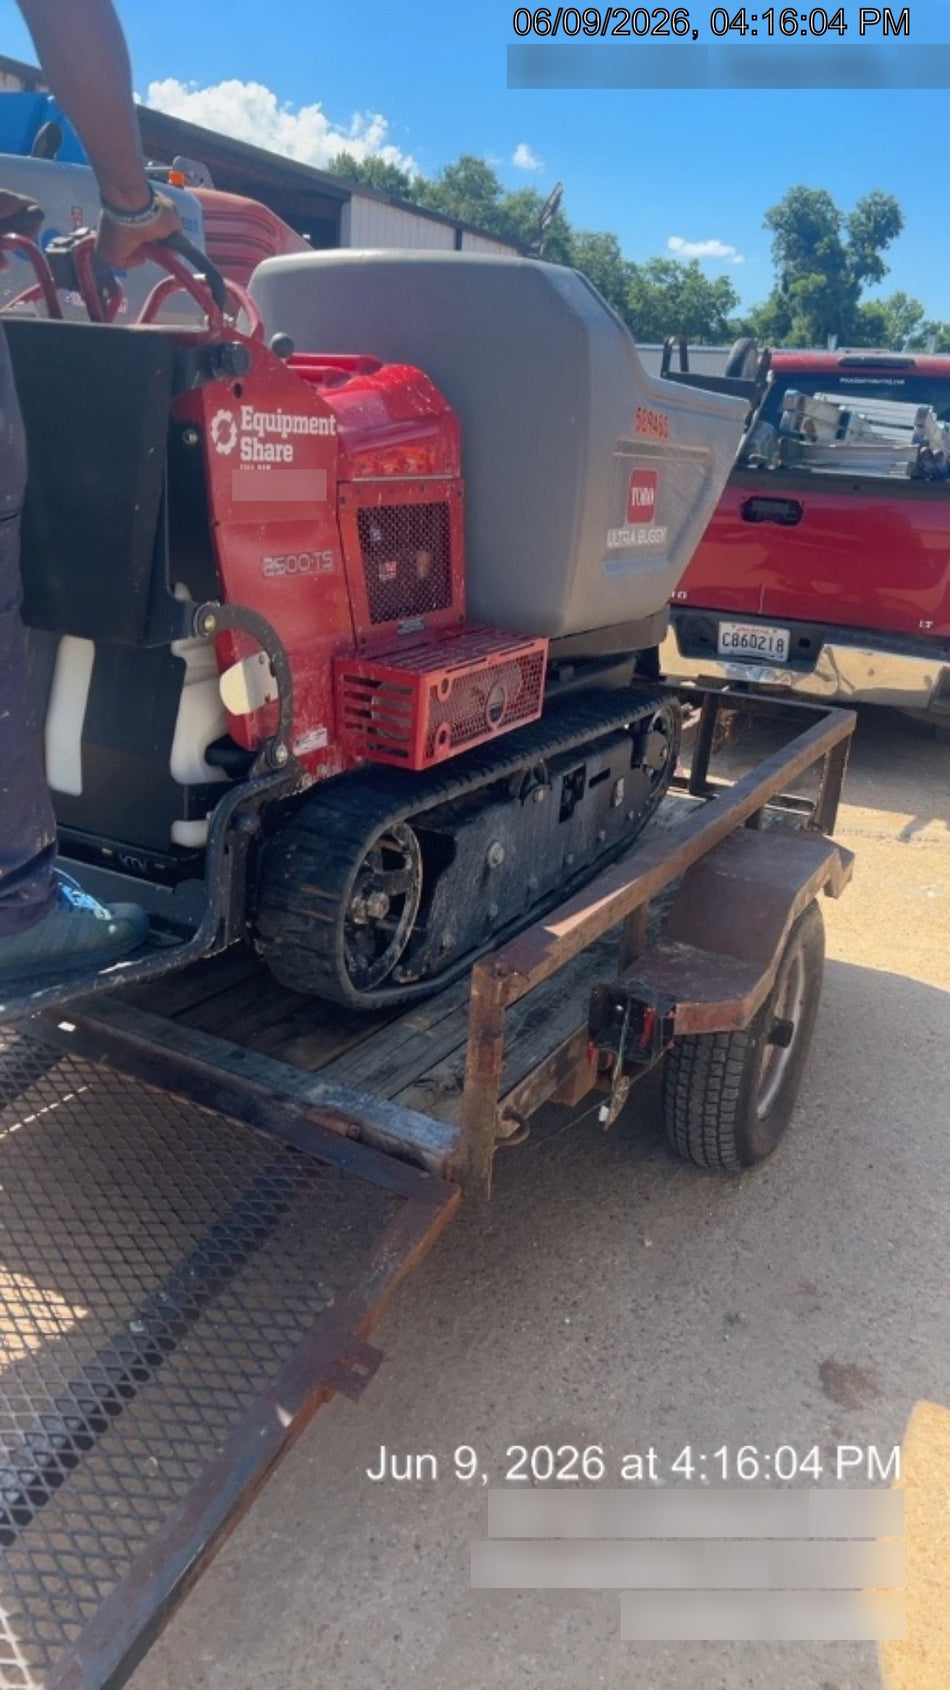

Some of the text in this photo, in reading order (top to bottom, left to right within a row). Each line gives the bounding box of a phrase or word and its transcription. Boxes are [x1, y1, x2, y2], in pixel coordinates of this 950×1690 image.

[240, 405, 336, 438] Equipment
[240, 437, 294, 462] Share
[631, 487, 654, 507] TORO
[607, 526, 668, 547] ULTRA BUGGY
[722, 632, 785, 654] C860218
